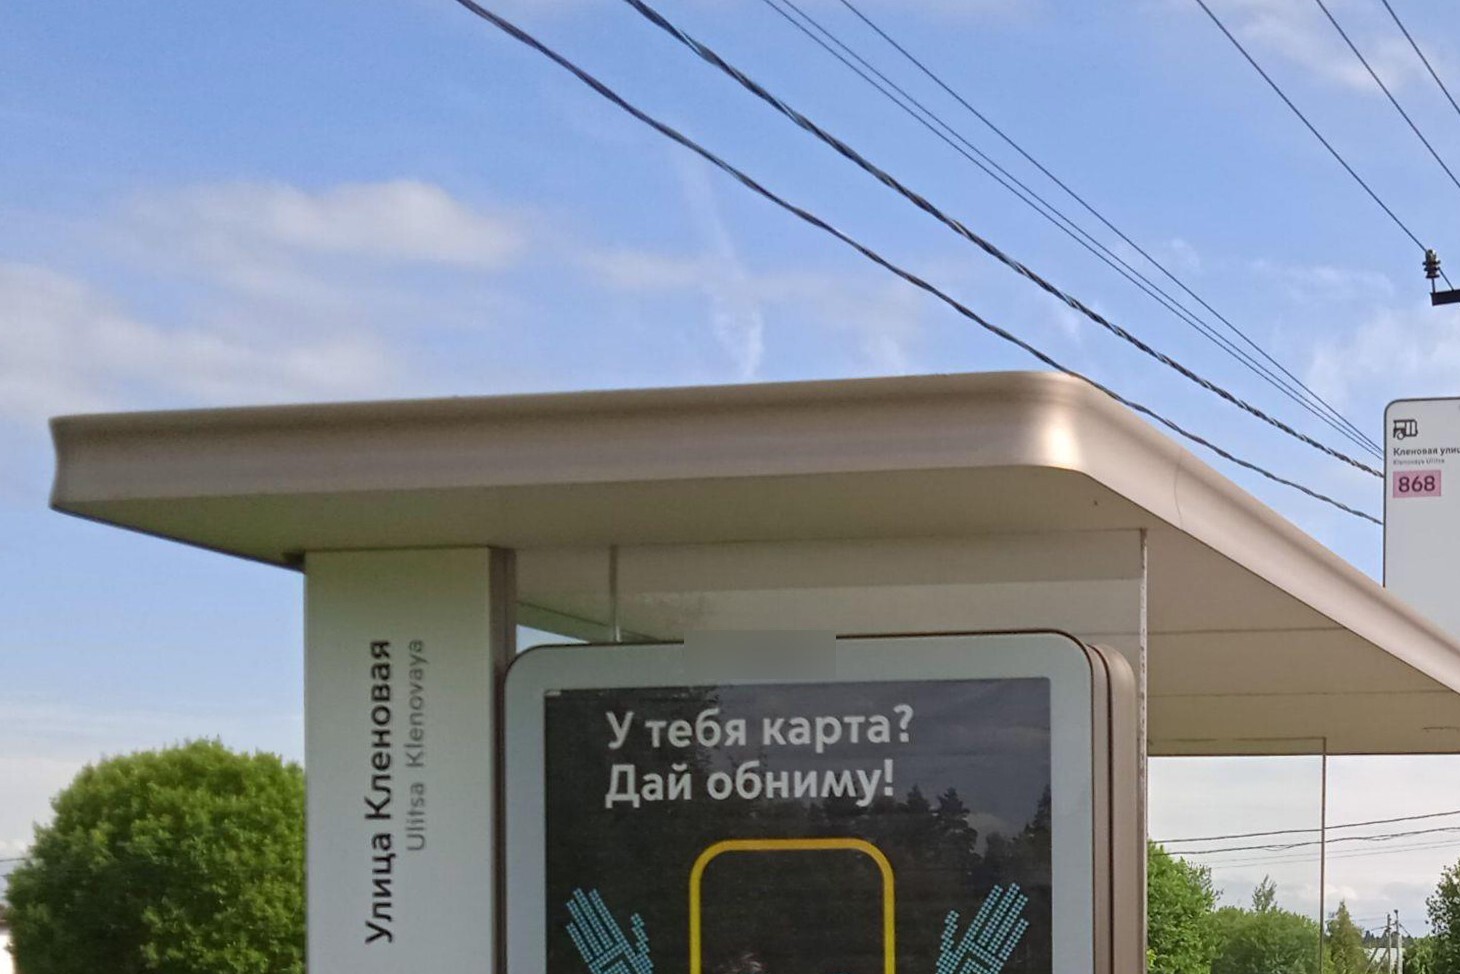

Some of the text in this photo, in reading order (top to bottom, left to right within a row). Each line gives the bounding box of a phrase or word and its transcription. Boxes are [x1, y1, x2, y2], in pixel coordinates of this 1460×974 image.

[1393, 447, 1438, 456] Кленовая
[1398, 475, 1436, 493] 868
[404, 638, 429, 851] Ulitsa Klenovaya
[605, 704, 914, 753] У тебя карта?
[364, 640, 396, 945] Улица Кленовая
[605, 759, 894, 808] Дай обниму!
